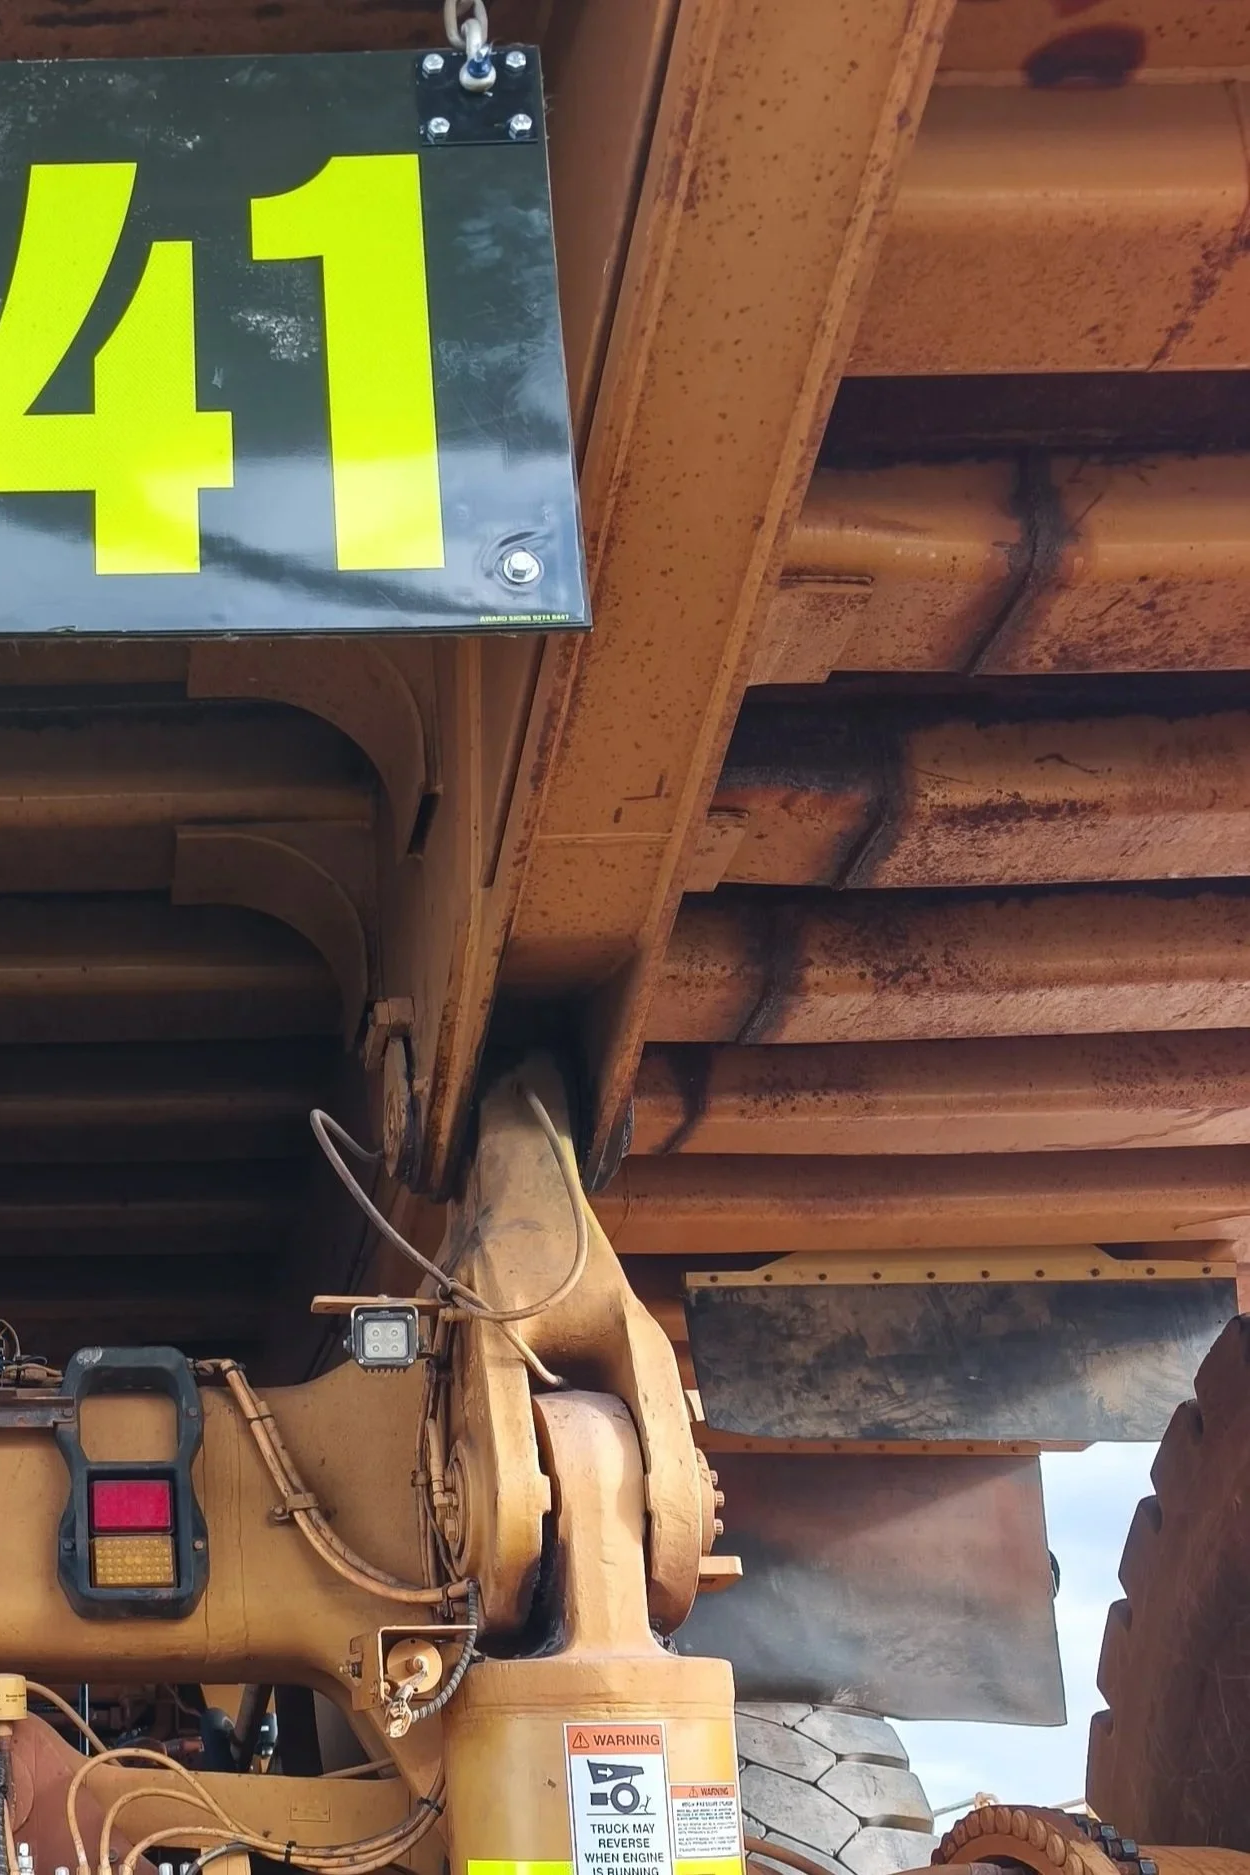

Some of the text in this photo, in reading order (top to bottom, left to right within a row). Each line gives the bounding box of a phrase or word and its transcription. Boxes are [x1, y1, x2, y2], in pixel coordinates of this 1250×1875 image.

[593, 1734, 660, 1747] WARNING
[700, 1787, 729, 1796] WARNING
[590, 1823, 655, 1834] TRUCK MAY
[598, 1838, 650, 1848] REVERSE
[584, 1852, 664, 1863] WHEN ENGINE
[593, 1867, 659, 1875] IS RUNNING
